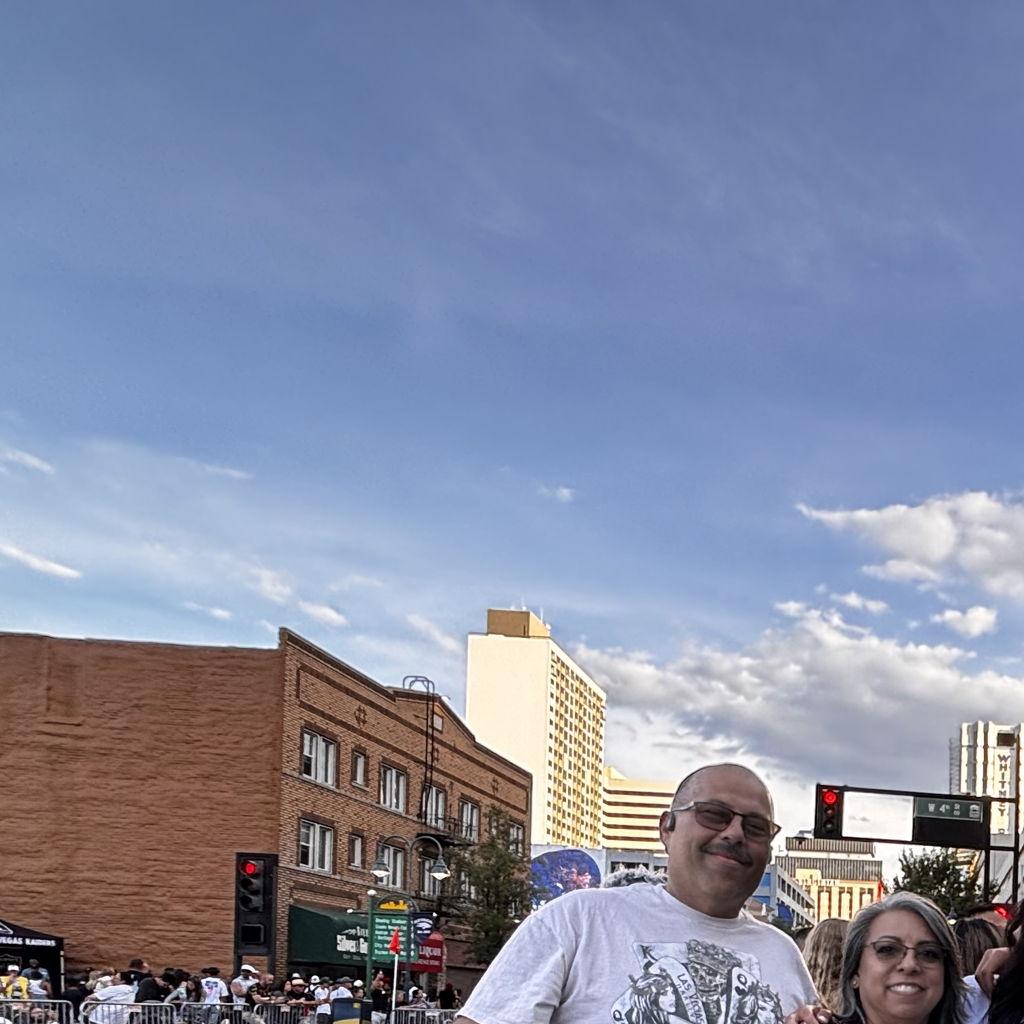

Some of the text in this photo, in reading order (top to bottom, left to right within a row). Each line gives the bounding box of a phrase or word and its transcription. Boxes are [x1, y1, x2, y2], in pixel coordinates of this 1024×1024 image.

[928, 803, 935, 812] W
[25, 938, 56, 947] RAIDERS
[677, 973, 692, 992] LAS
